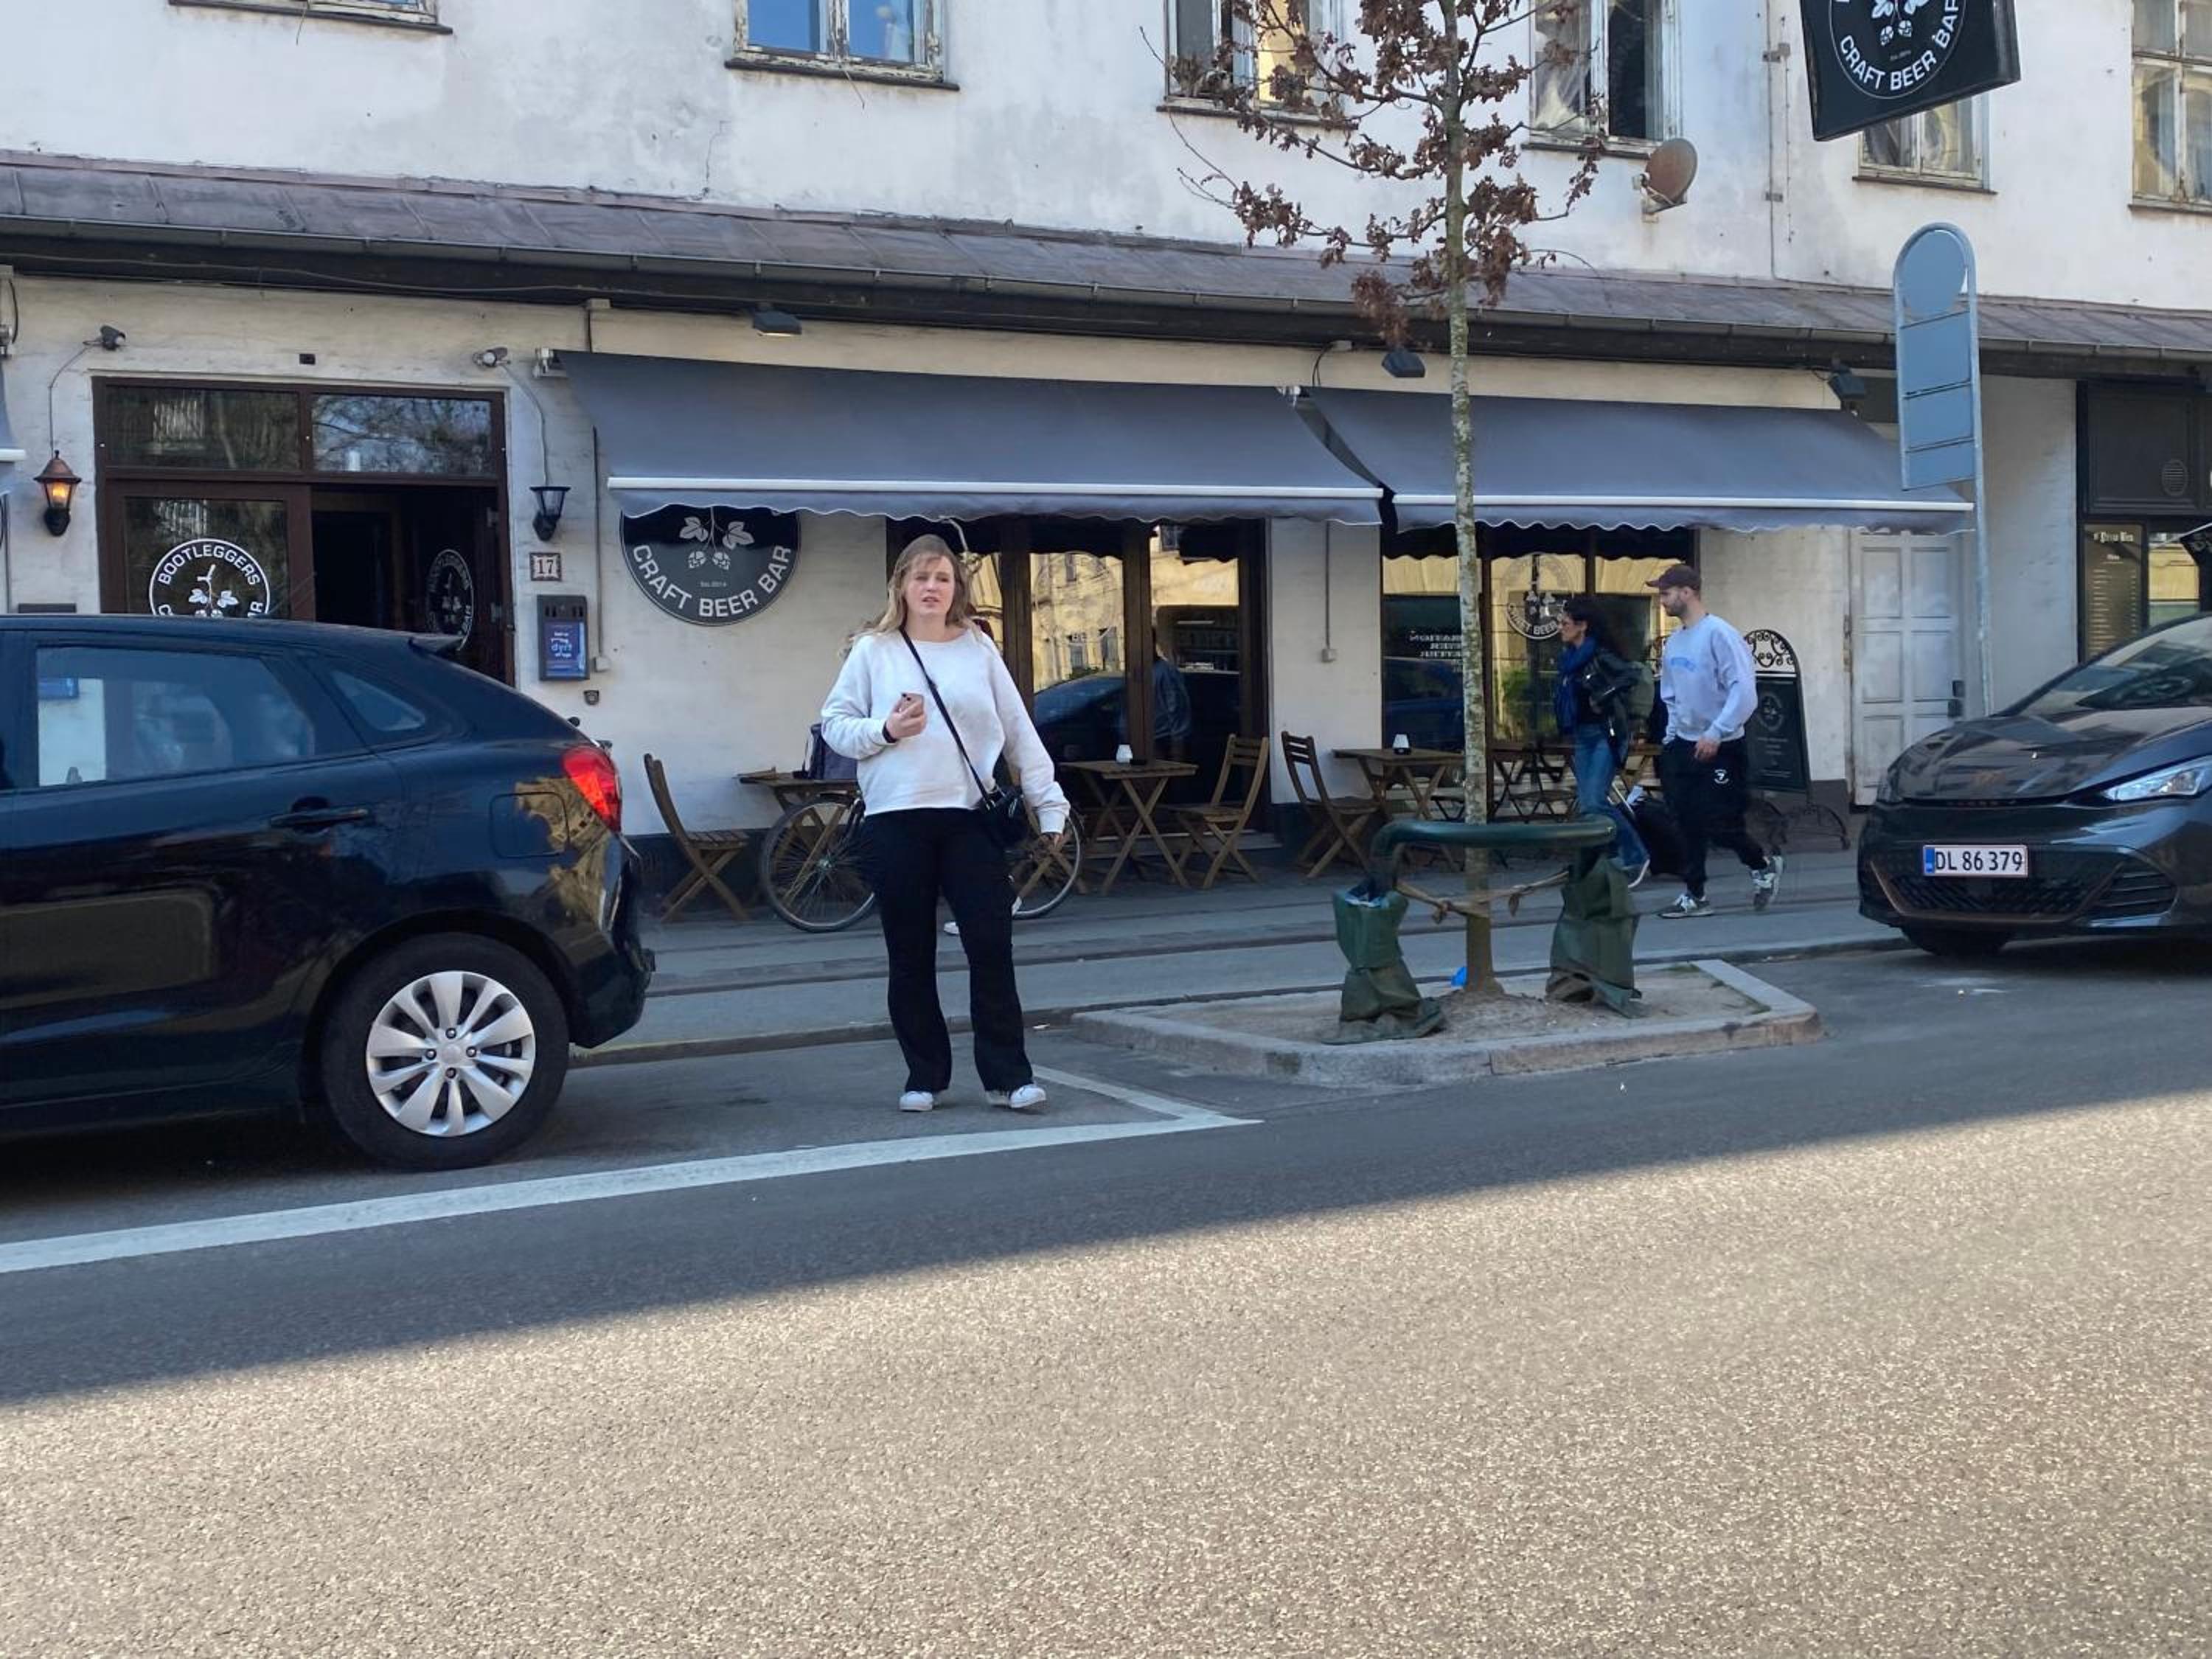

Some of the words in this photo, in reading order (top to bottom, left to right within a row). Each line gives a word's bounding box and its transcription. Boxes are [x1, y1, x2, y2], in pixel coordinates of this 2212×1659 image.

[1840, 35, 1885, 89] CRAFT
[1890, 49, 1937, 91] BEER
[158, 544, 260, 585] BOOTLEGGERS
[536, 559, 554, 574] 17
[633, 545, 692, 609] CRAFT
[698, 589, 759, 617] BEER
[758, 546, 791, 594] BAR
[1935, 851, 1957, 871] DL
[1962, 851, 1983, 871] 86
[1989, 851, 2023, 872] 379
